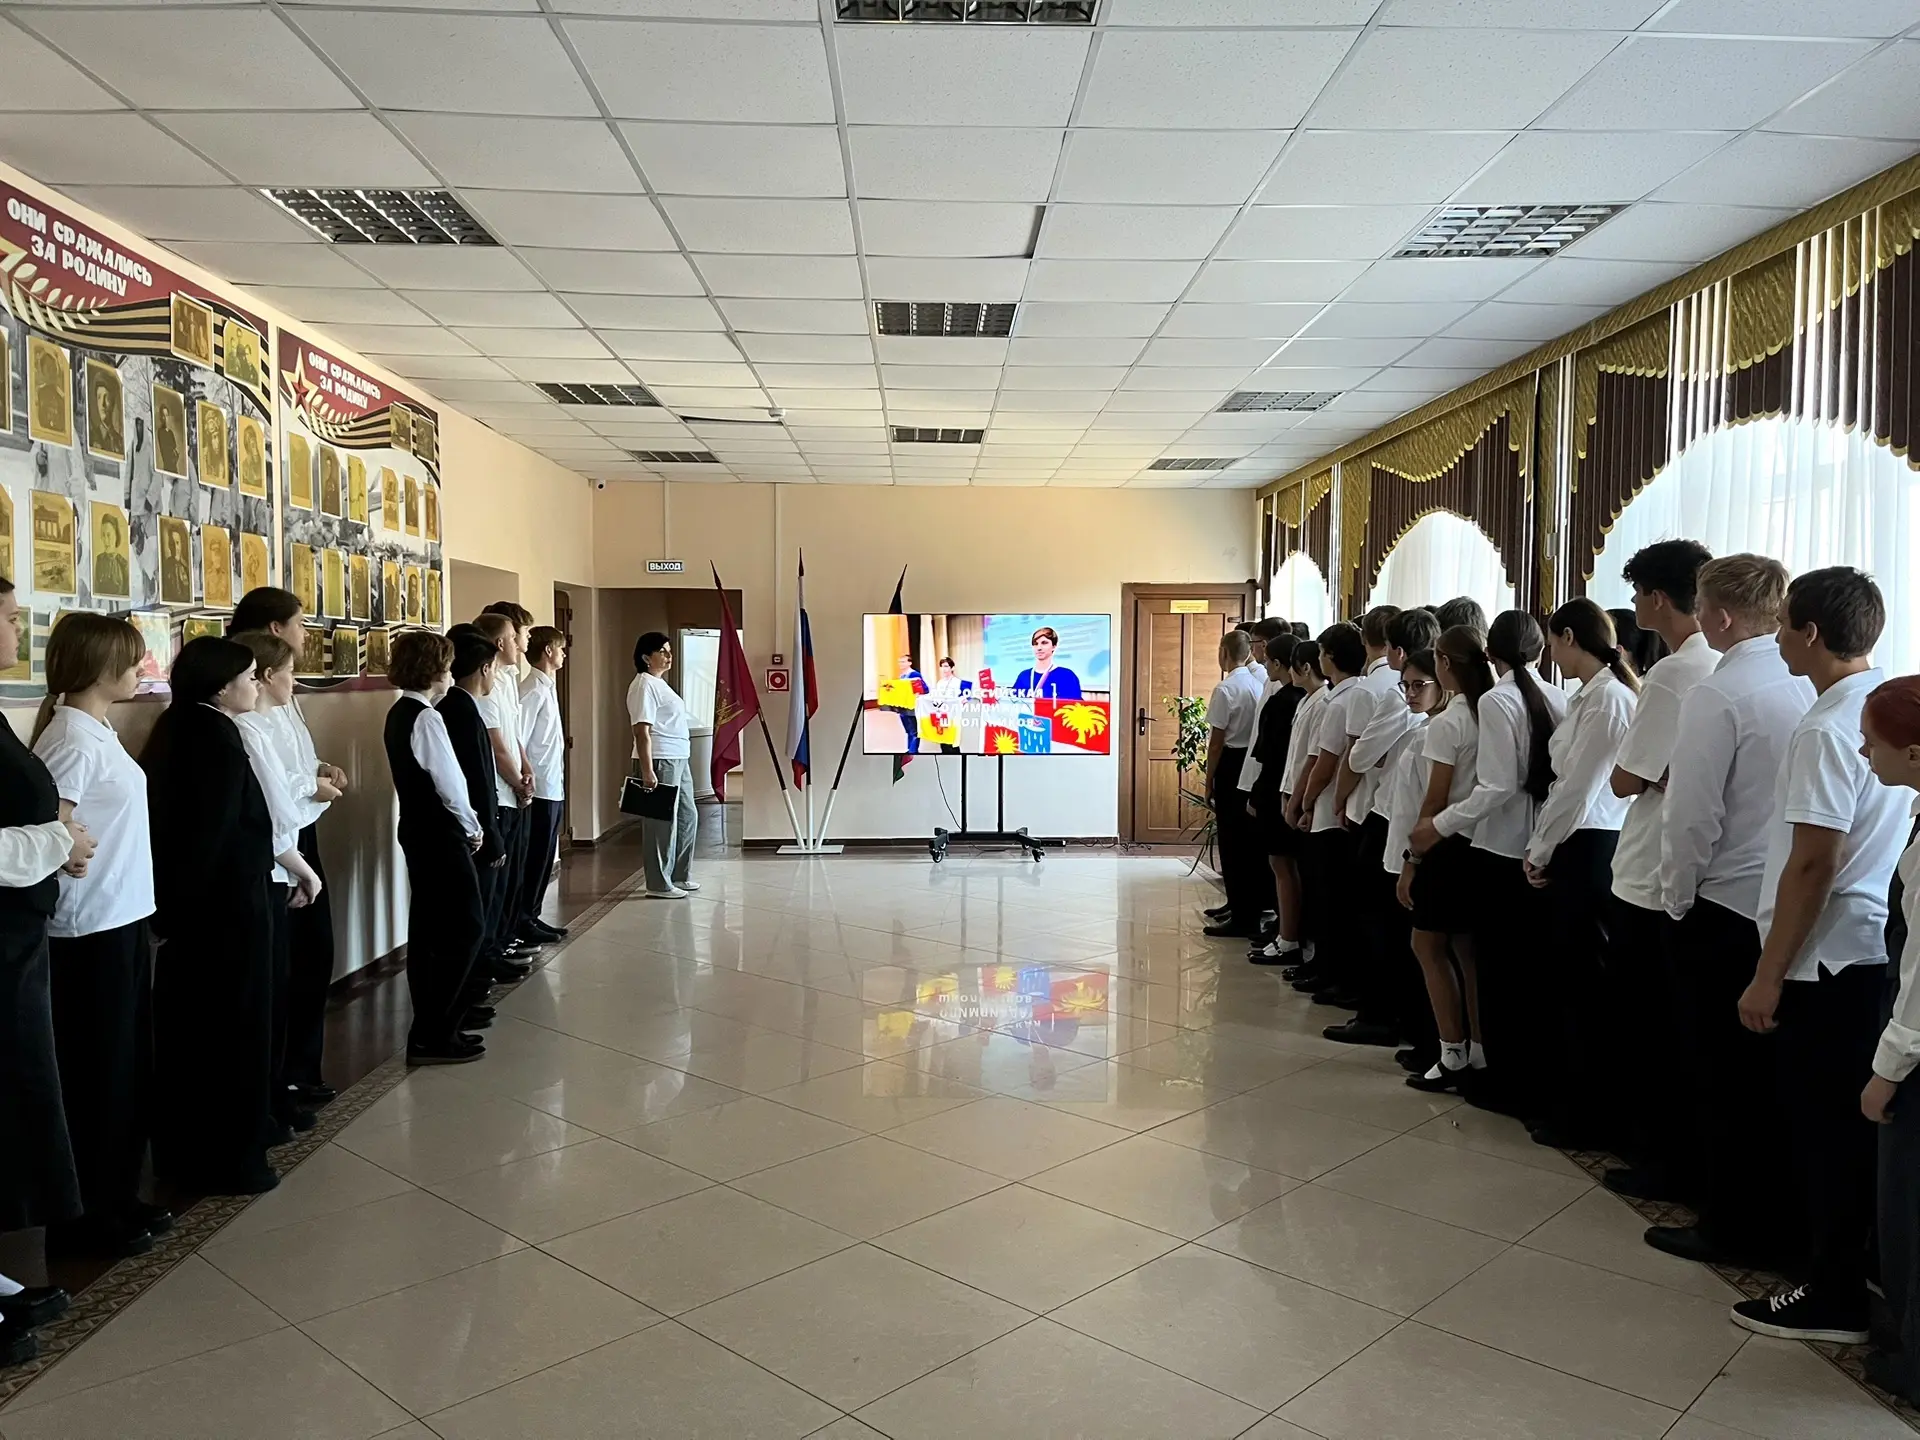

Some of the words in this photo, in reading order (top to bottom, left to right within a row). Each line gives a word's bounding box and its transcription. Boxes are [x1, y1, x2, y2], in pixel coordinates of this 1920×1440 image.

[7, 197, 47, 234] ОНИ
[53, 221, 153, 287] СРАЖАЛИСЬ
[30, 235, 56, 264] ЗА
[62, 249, 127, 297] РОДИНУ
[308, 351, 328, 373] ОНИ
[331, 363, 381, 400] СРАЖАЛИСЬ
[320, 375, 333, 393] ЗА
[335, 381, 368, 409] РОДИНУ
[649, 562, 681, 571] ВЫХОД
[939, 717, 1034, 728] ШОЛИКОВ
